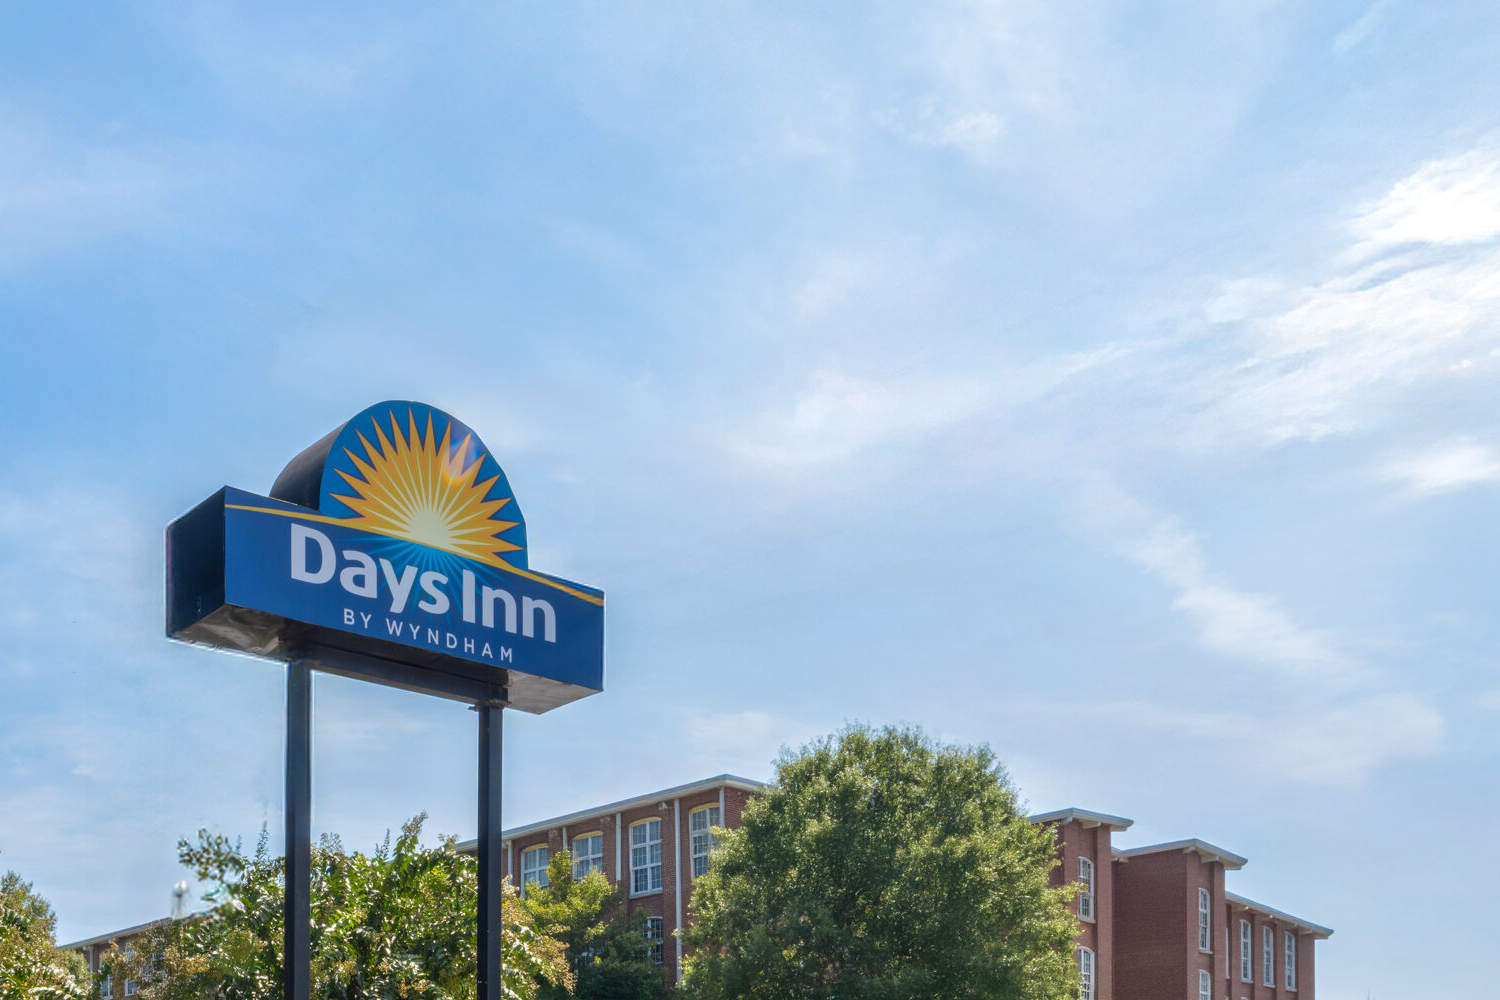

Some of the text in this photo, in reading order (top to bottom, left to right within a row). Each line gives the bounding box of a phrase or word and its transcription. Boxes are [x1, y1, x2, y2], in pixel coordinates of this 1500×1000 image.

[290, 523, 556, 643] Days Inn
[343, 608, 513, 663] BY WYNDHAM
